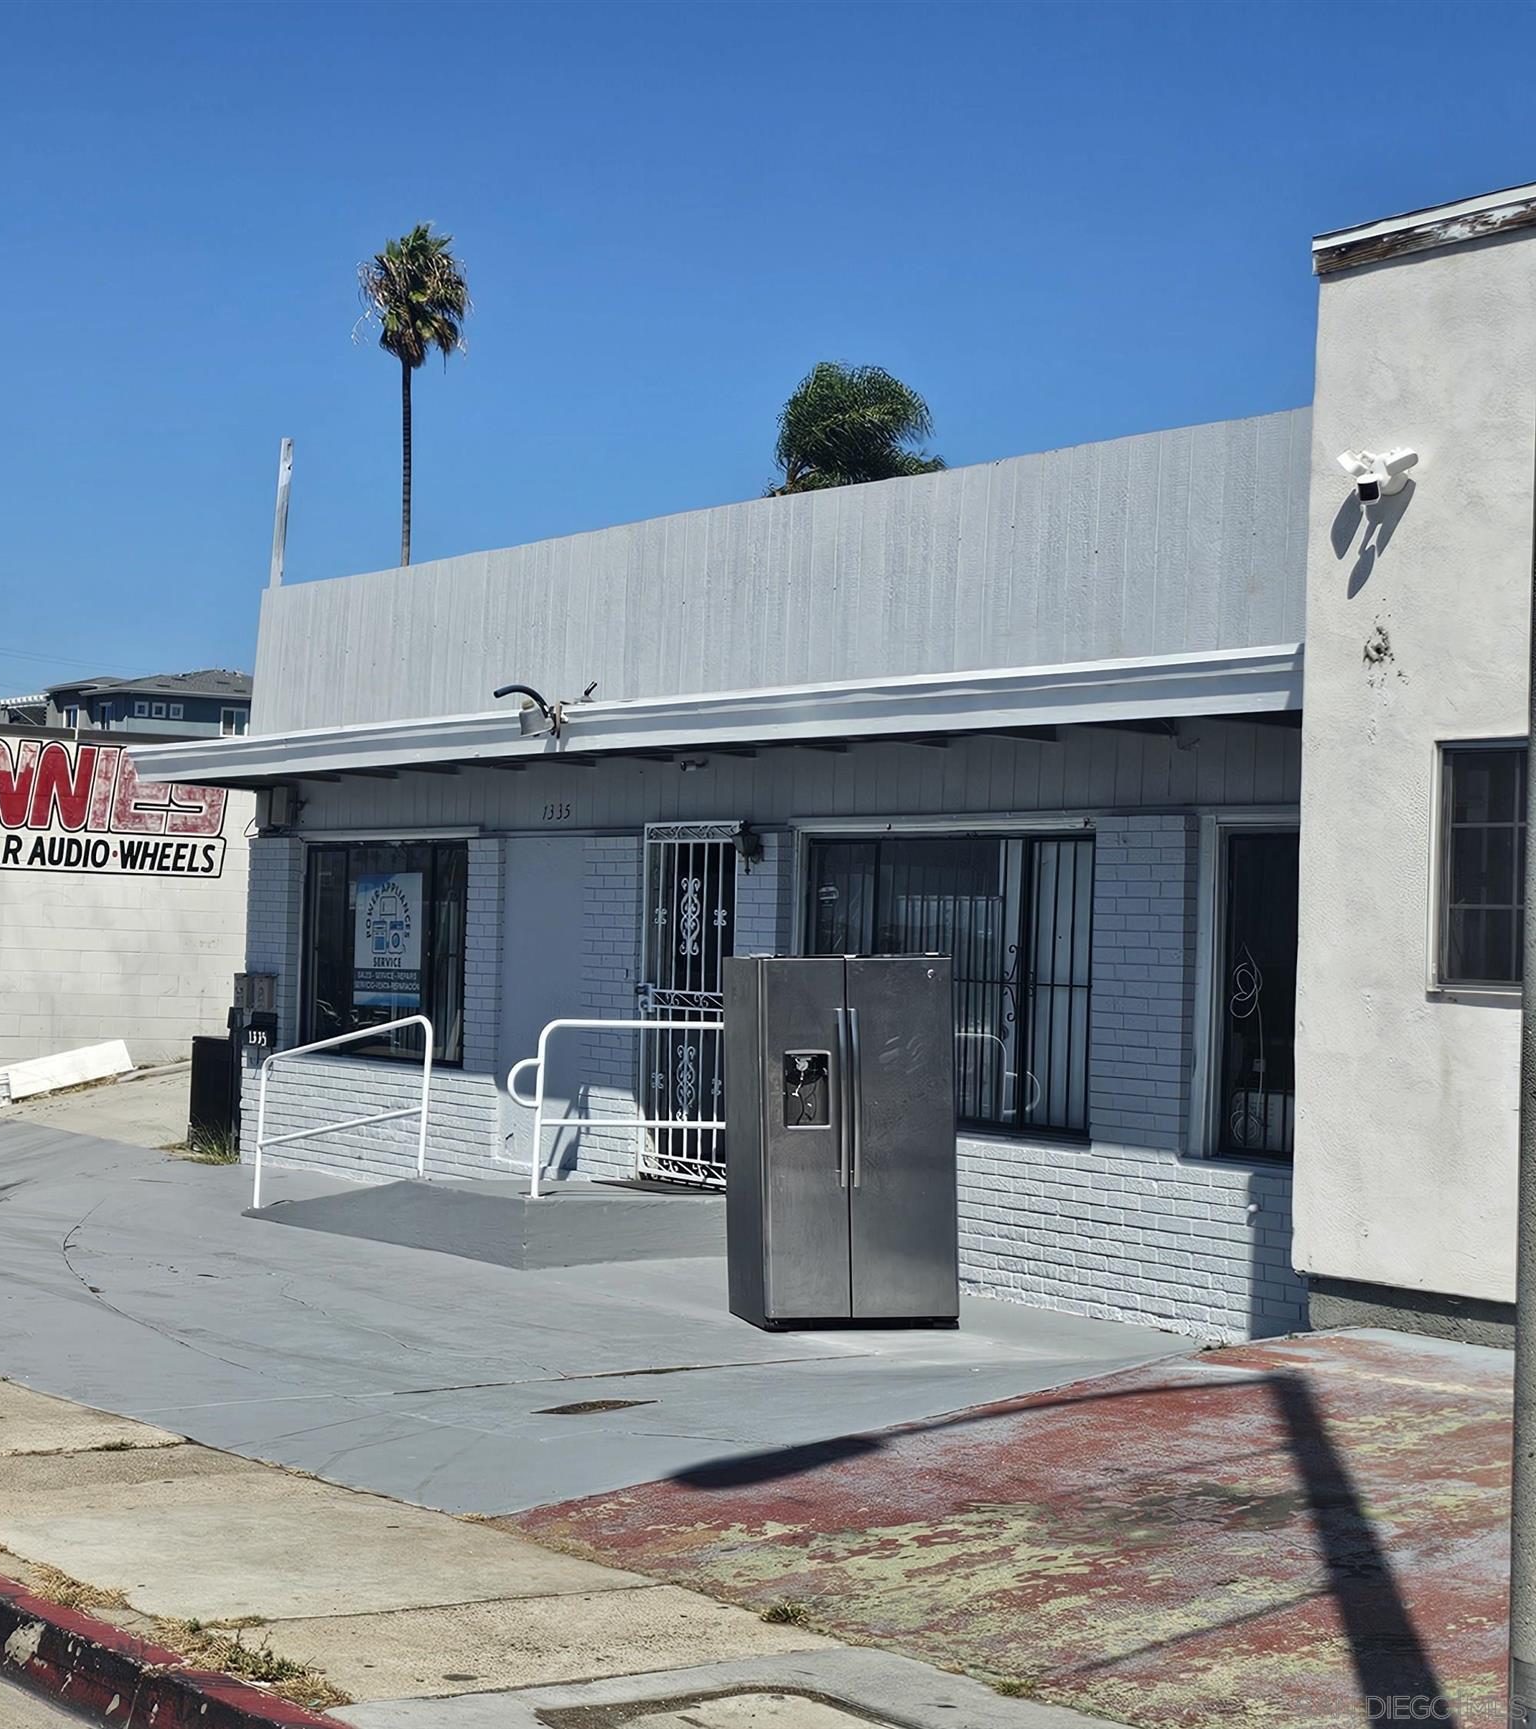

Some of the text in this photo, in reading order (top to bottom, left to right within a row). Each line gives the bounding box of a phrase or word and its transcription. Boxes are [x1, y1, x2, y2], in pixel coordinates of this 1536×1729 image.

[542, 803, 570, 820] 1335
[27, 836, 110, 869] AUDIO
[119, 839, 215, 873] WHEELS
[373, 957, 401, 968] SERVICE
[248, 1030, 267, 1047] 1335
